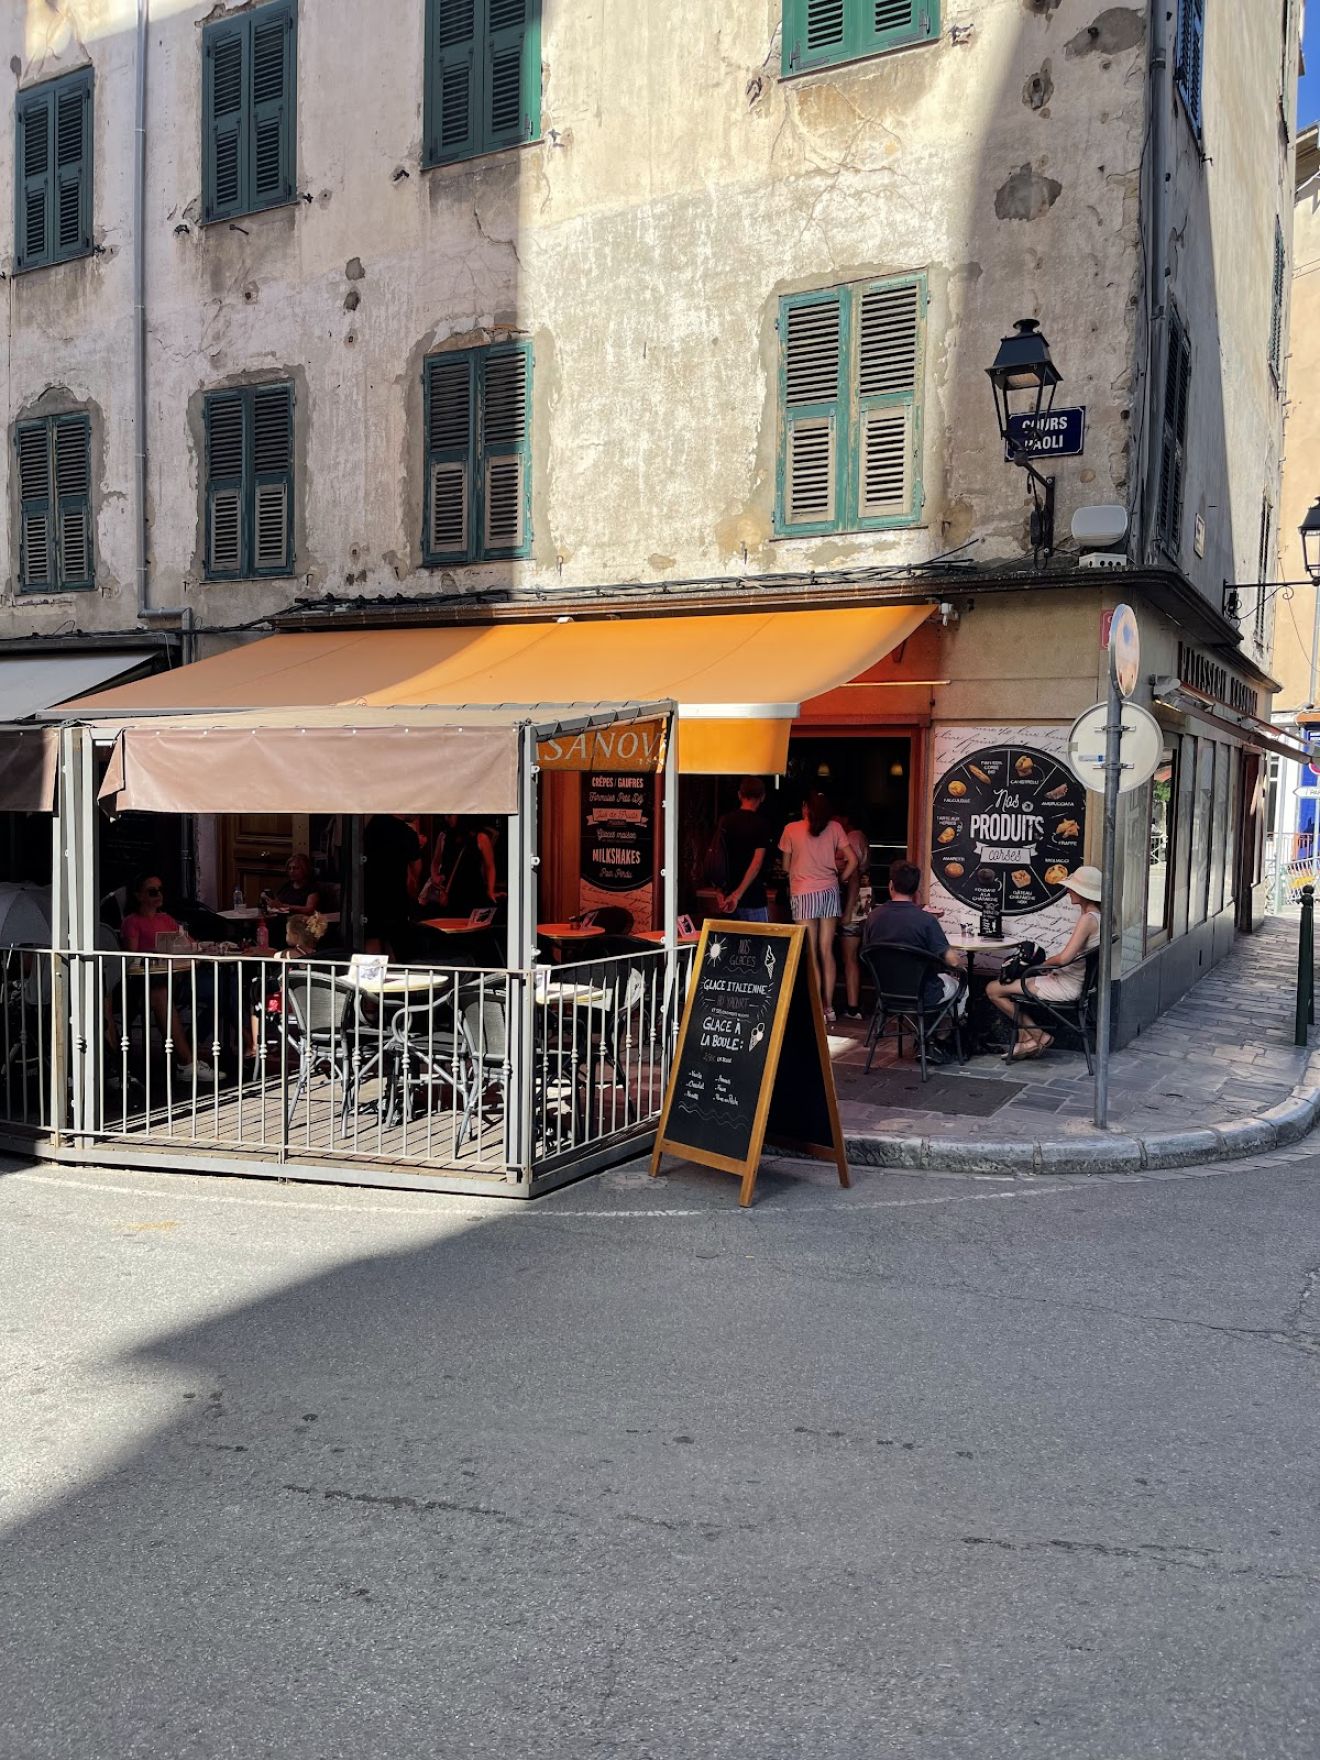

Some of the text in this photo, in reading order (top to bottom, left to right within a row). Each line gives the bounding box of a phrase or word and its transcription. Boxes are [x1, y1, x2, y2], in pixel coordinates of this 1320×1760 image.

[618, 778, 644, 788] GAUFRES
[993, 789, 1020, 812] Nos
[970, 813, 1045, 841] PRODUITS
[592, 848, 641, 865] MILKSHAKES
[989, 849, 1021, 862] corses
[729, 956, 756, 967] GLACES
[704, 979, 768, 995] GLACE ITALIENNE
[703, 1016, 732, 1033] GLACE
[700, 1033, 710, 1046] LA
